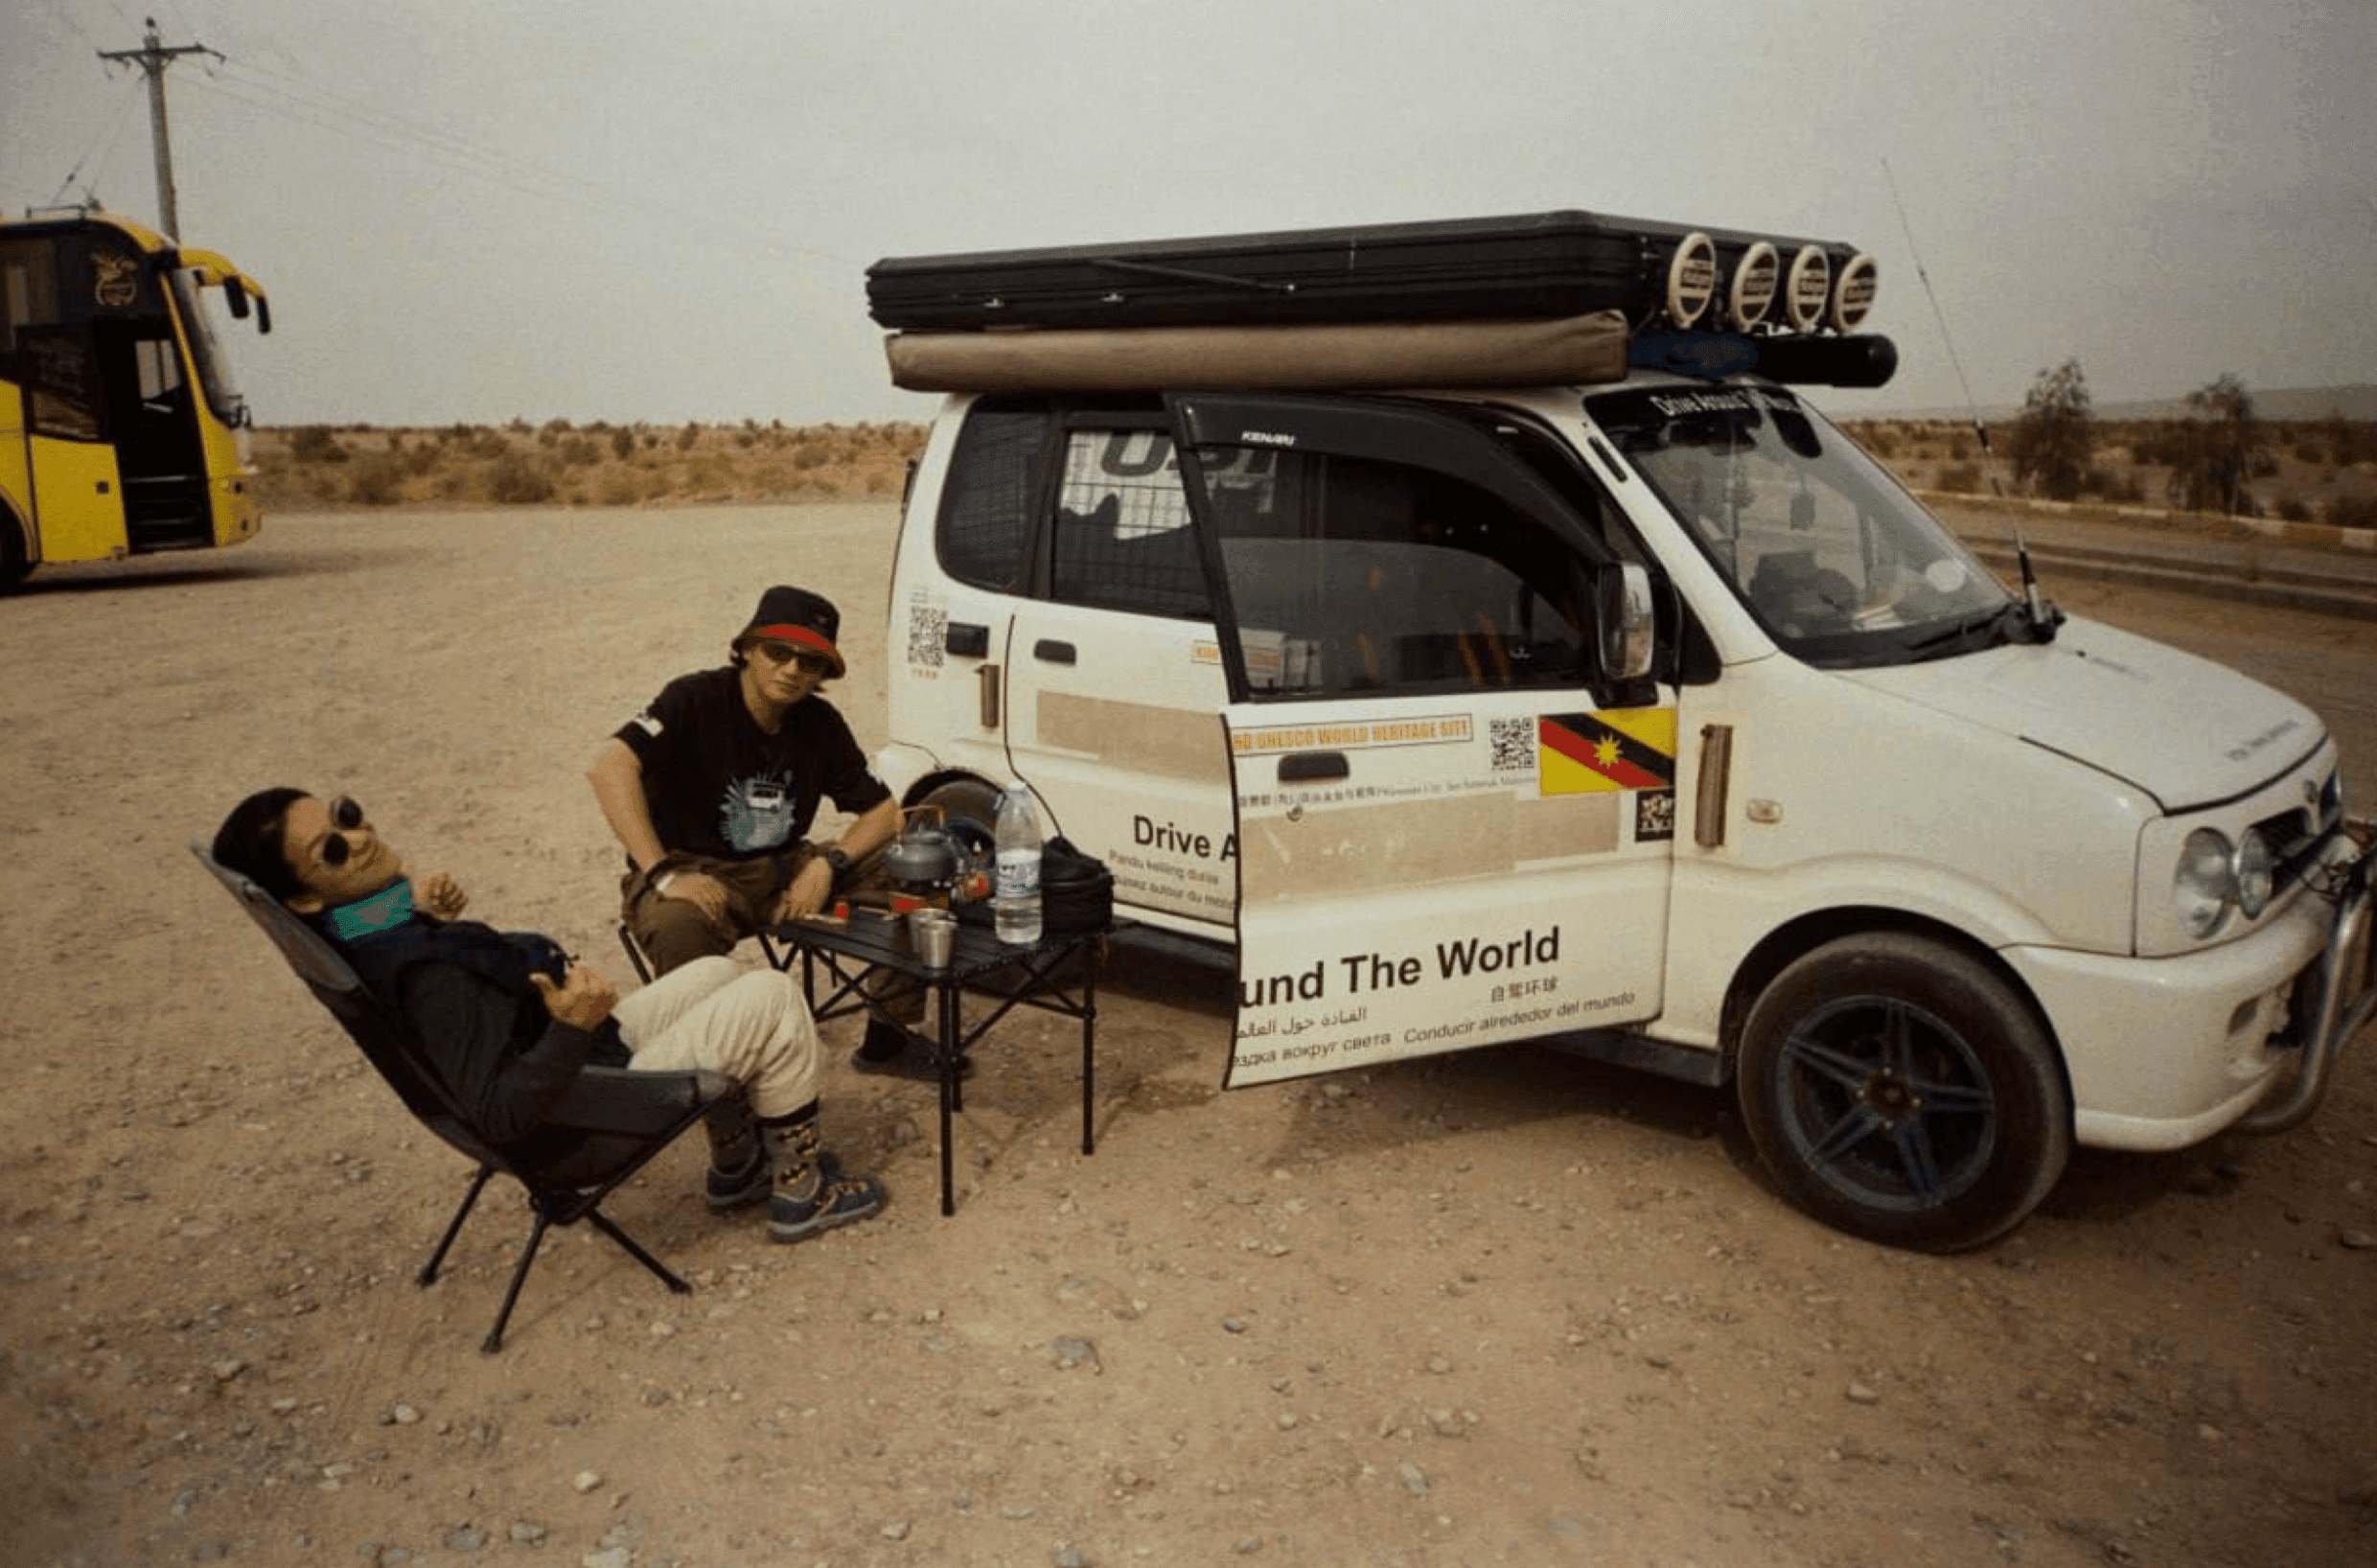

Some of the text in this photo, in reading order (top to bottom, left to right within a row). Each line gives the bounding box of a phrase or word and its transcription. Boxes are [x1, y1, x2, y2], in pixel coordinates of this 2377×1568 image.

[1257, 728, 1316, 749] UNESCO
[1317, 726, 1370, 746] WORLD
[1372, 722, 1437, 742] HERITAGE
[1134, 815, 1212, 859] Drive
[1238, 925, 1560, 1008] und The World
[1403, 991, 1636, 1045] Conducir alrededor del mundo
[1342, 1031, 1392, 1052] света
